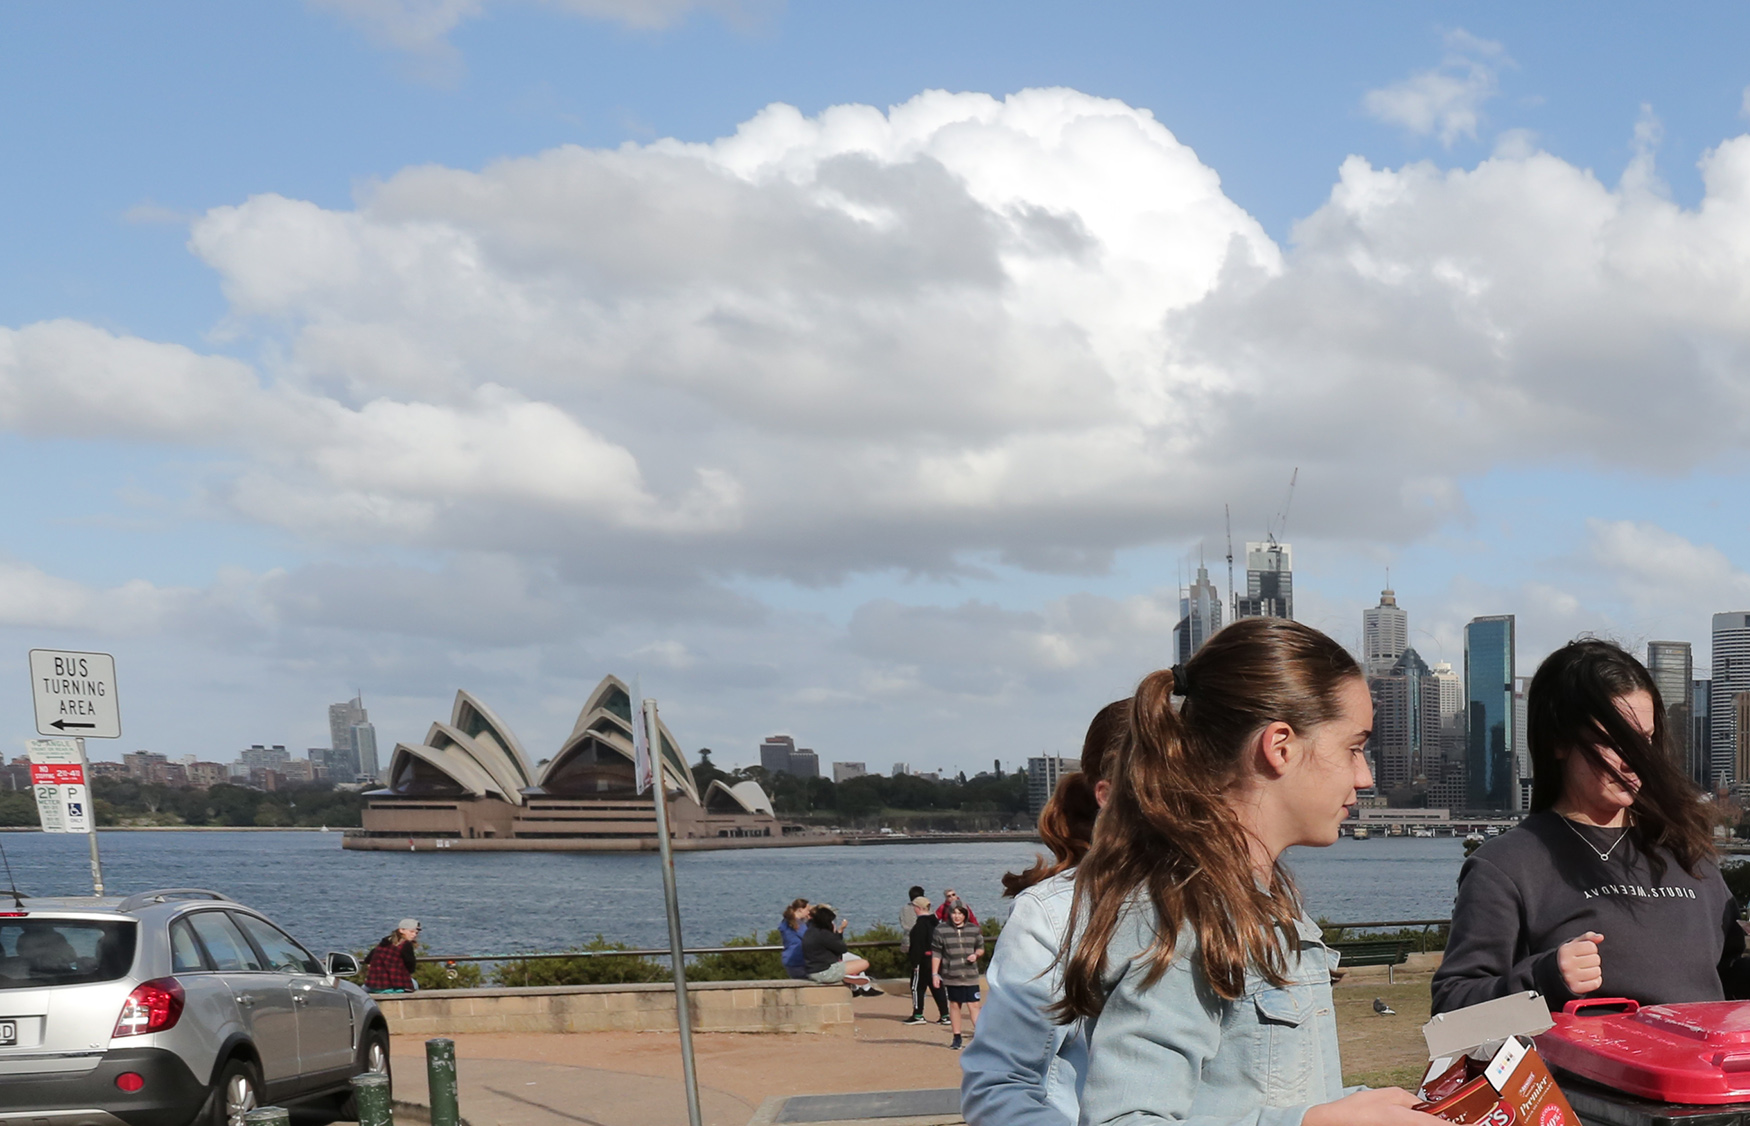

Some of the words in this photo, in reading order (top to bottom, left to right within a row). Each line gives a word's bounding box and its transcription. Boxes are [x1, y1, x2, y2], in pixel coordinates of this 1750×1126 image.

[55, 657, 88, 677] BUS
[43, 679, 105, 696] TURNING
[60, 700, 96, 715] AREA
[37, 788, 57, 799] 2P
[68, 788, 78, 799] P
[1520, 1075, 1548, 1116] Premier
